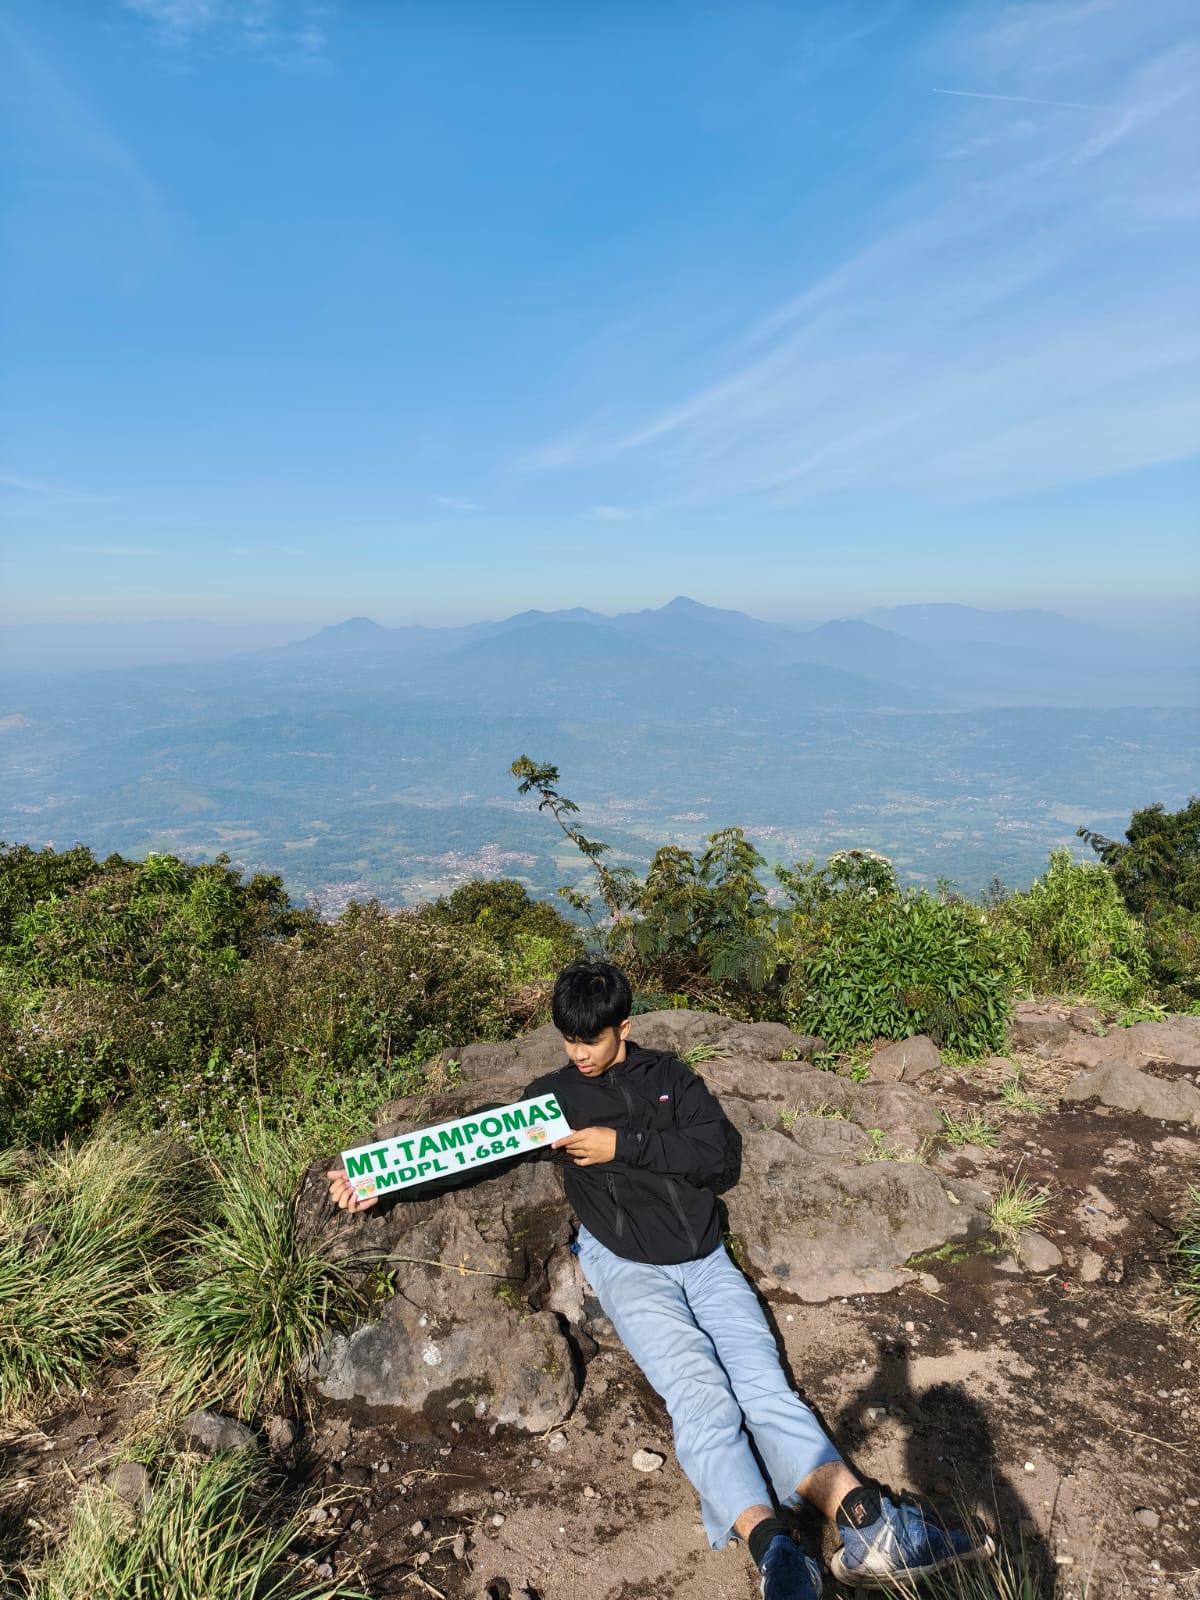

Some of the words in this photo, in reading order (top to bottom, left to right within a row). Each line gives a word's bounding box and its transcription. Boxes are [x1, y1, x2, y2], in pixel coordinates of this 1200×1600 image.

[345, 1099, 562, 1179] MT.TAMPOMAS
[374, 1158, 449, 1190] MDPL
[454, 1135, 520, 1165] 1.684
